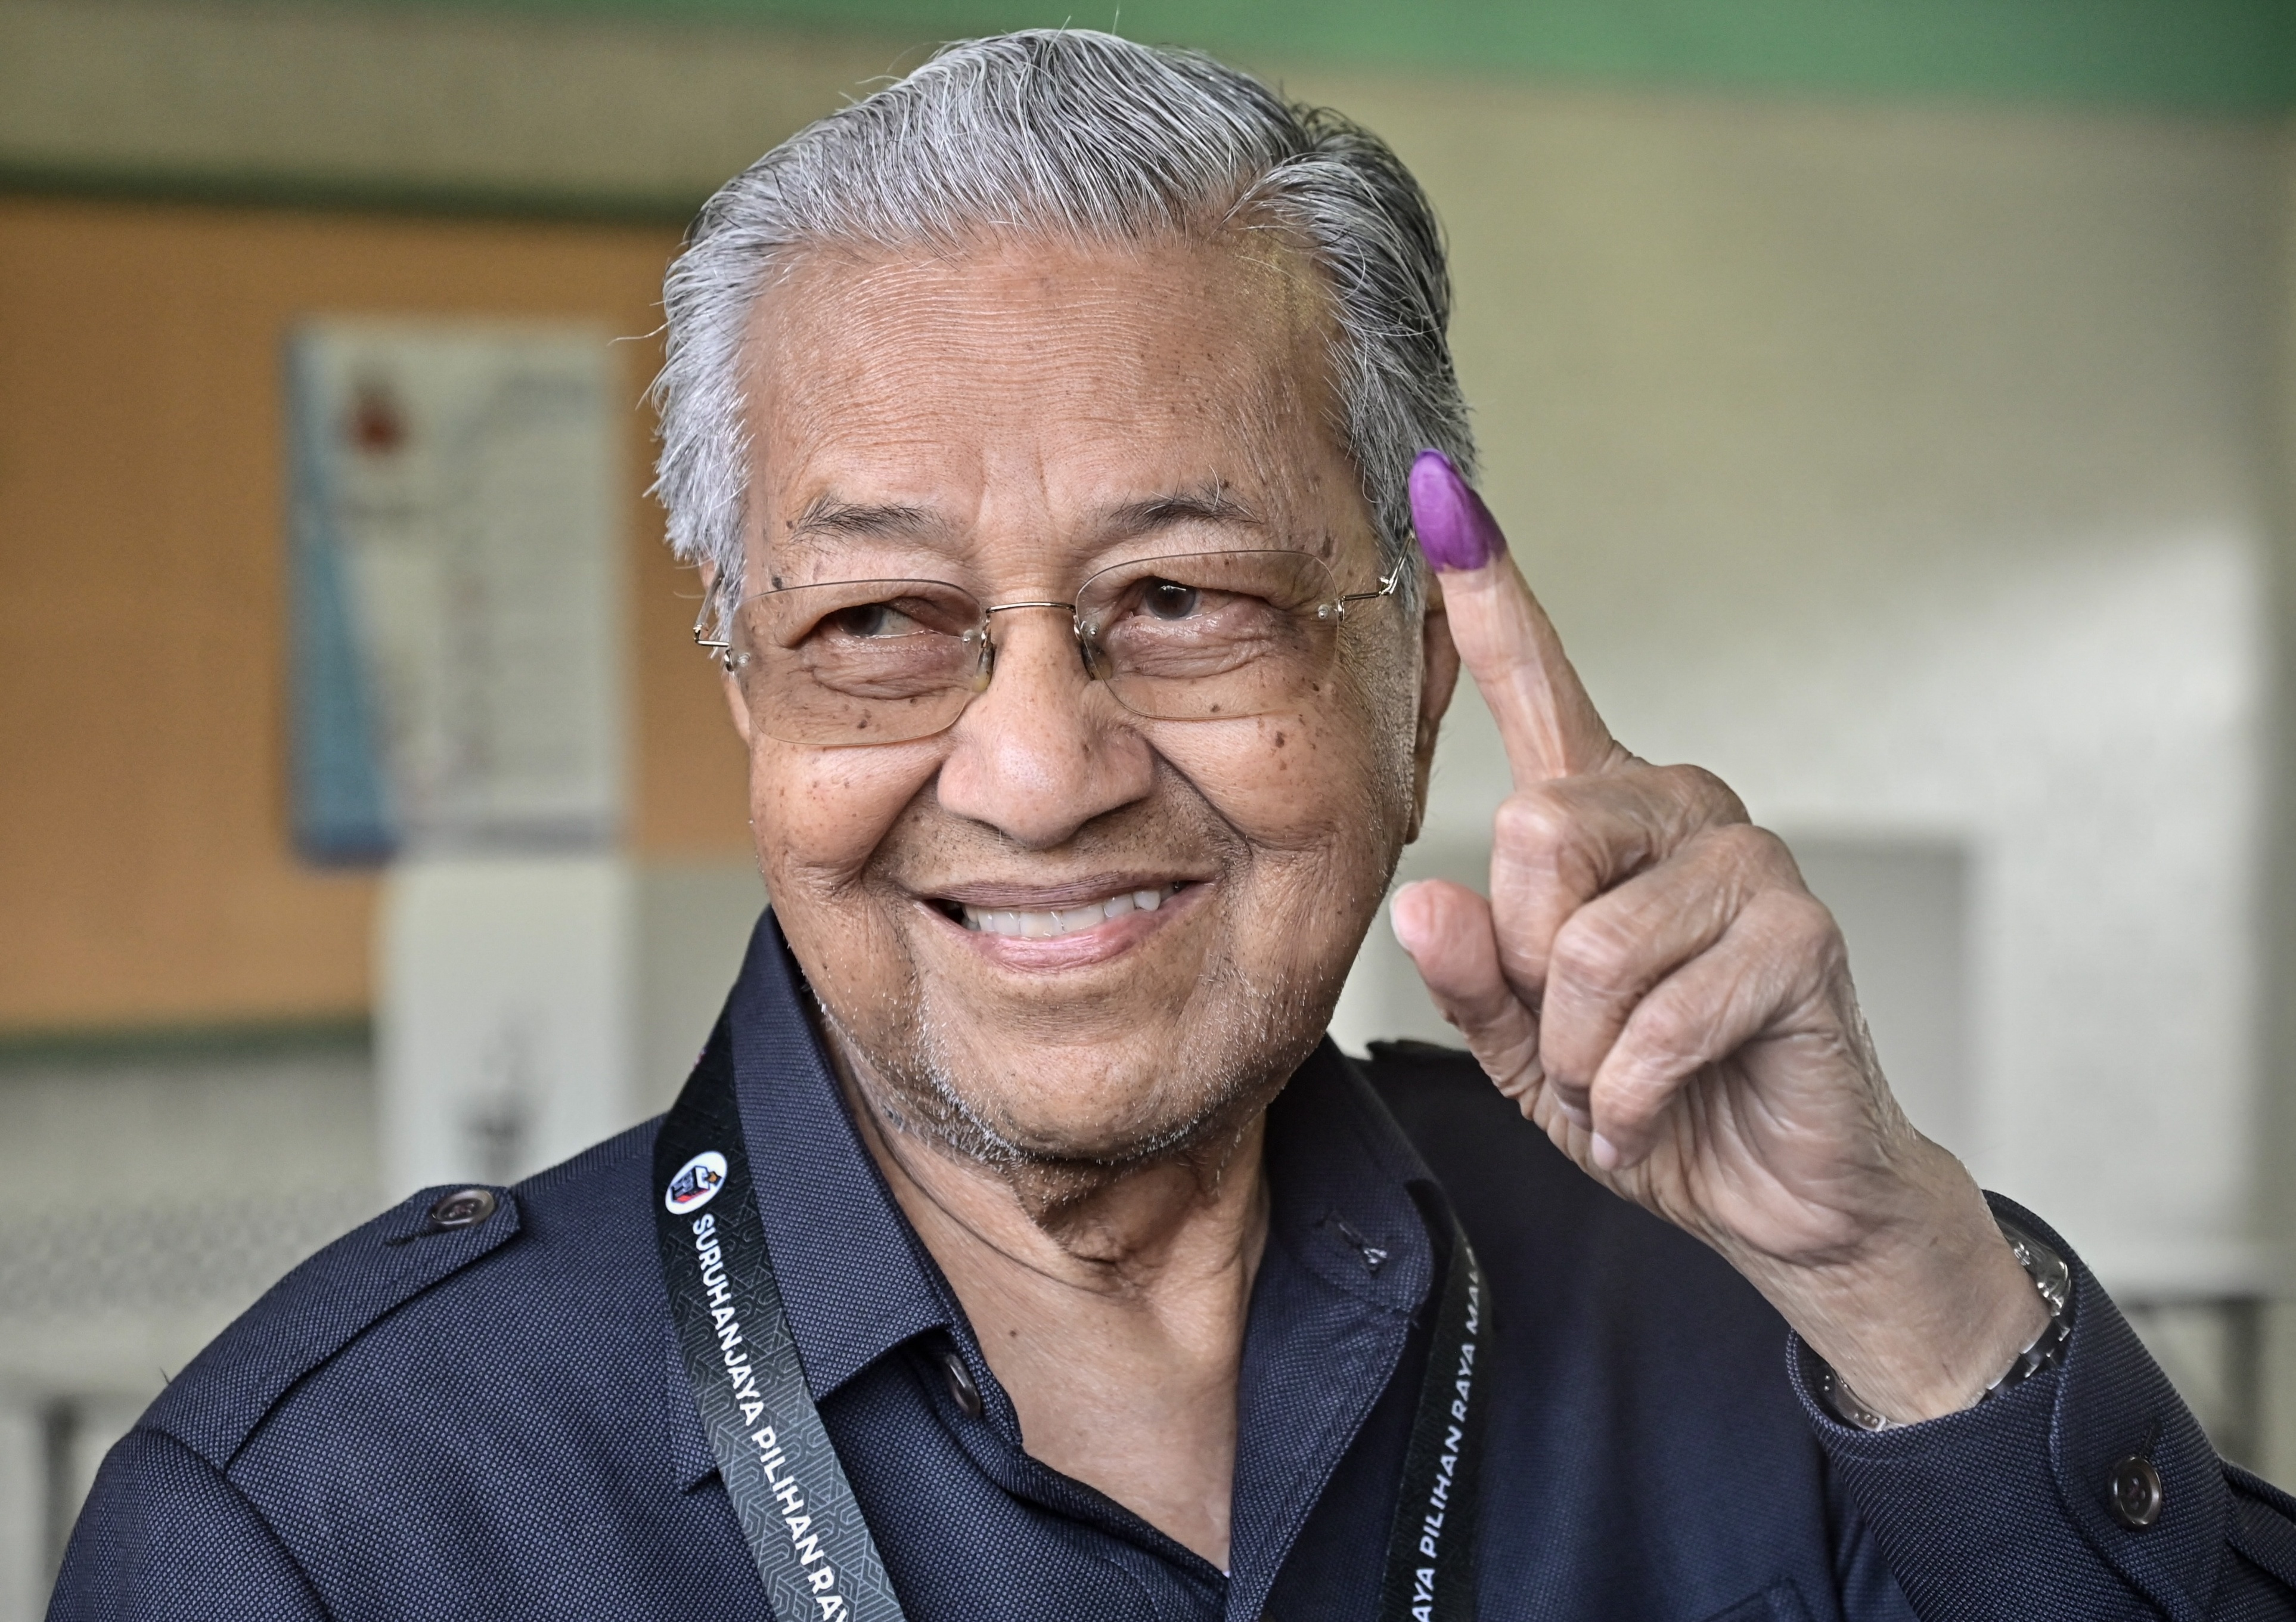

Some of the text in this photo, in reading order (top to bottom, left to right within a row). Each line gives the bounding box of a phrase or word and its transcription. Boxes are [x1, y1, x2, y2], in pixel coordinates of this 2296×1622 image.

[693, 1214, 765, 1426] SURUHANJAYA
[751, 1425, 825, 1565] PILIHAN
[1419, 1425, 1462, 1558] PILIHAN
[1451, 1344, 1475, 1422] RAYA
